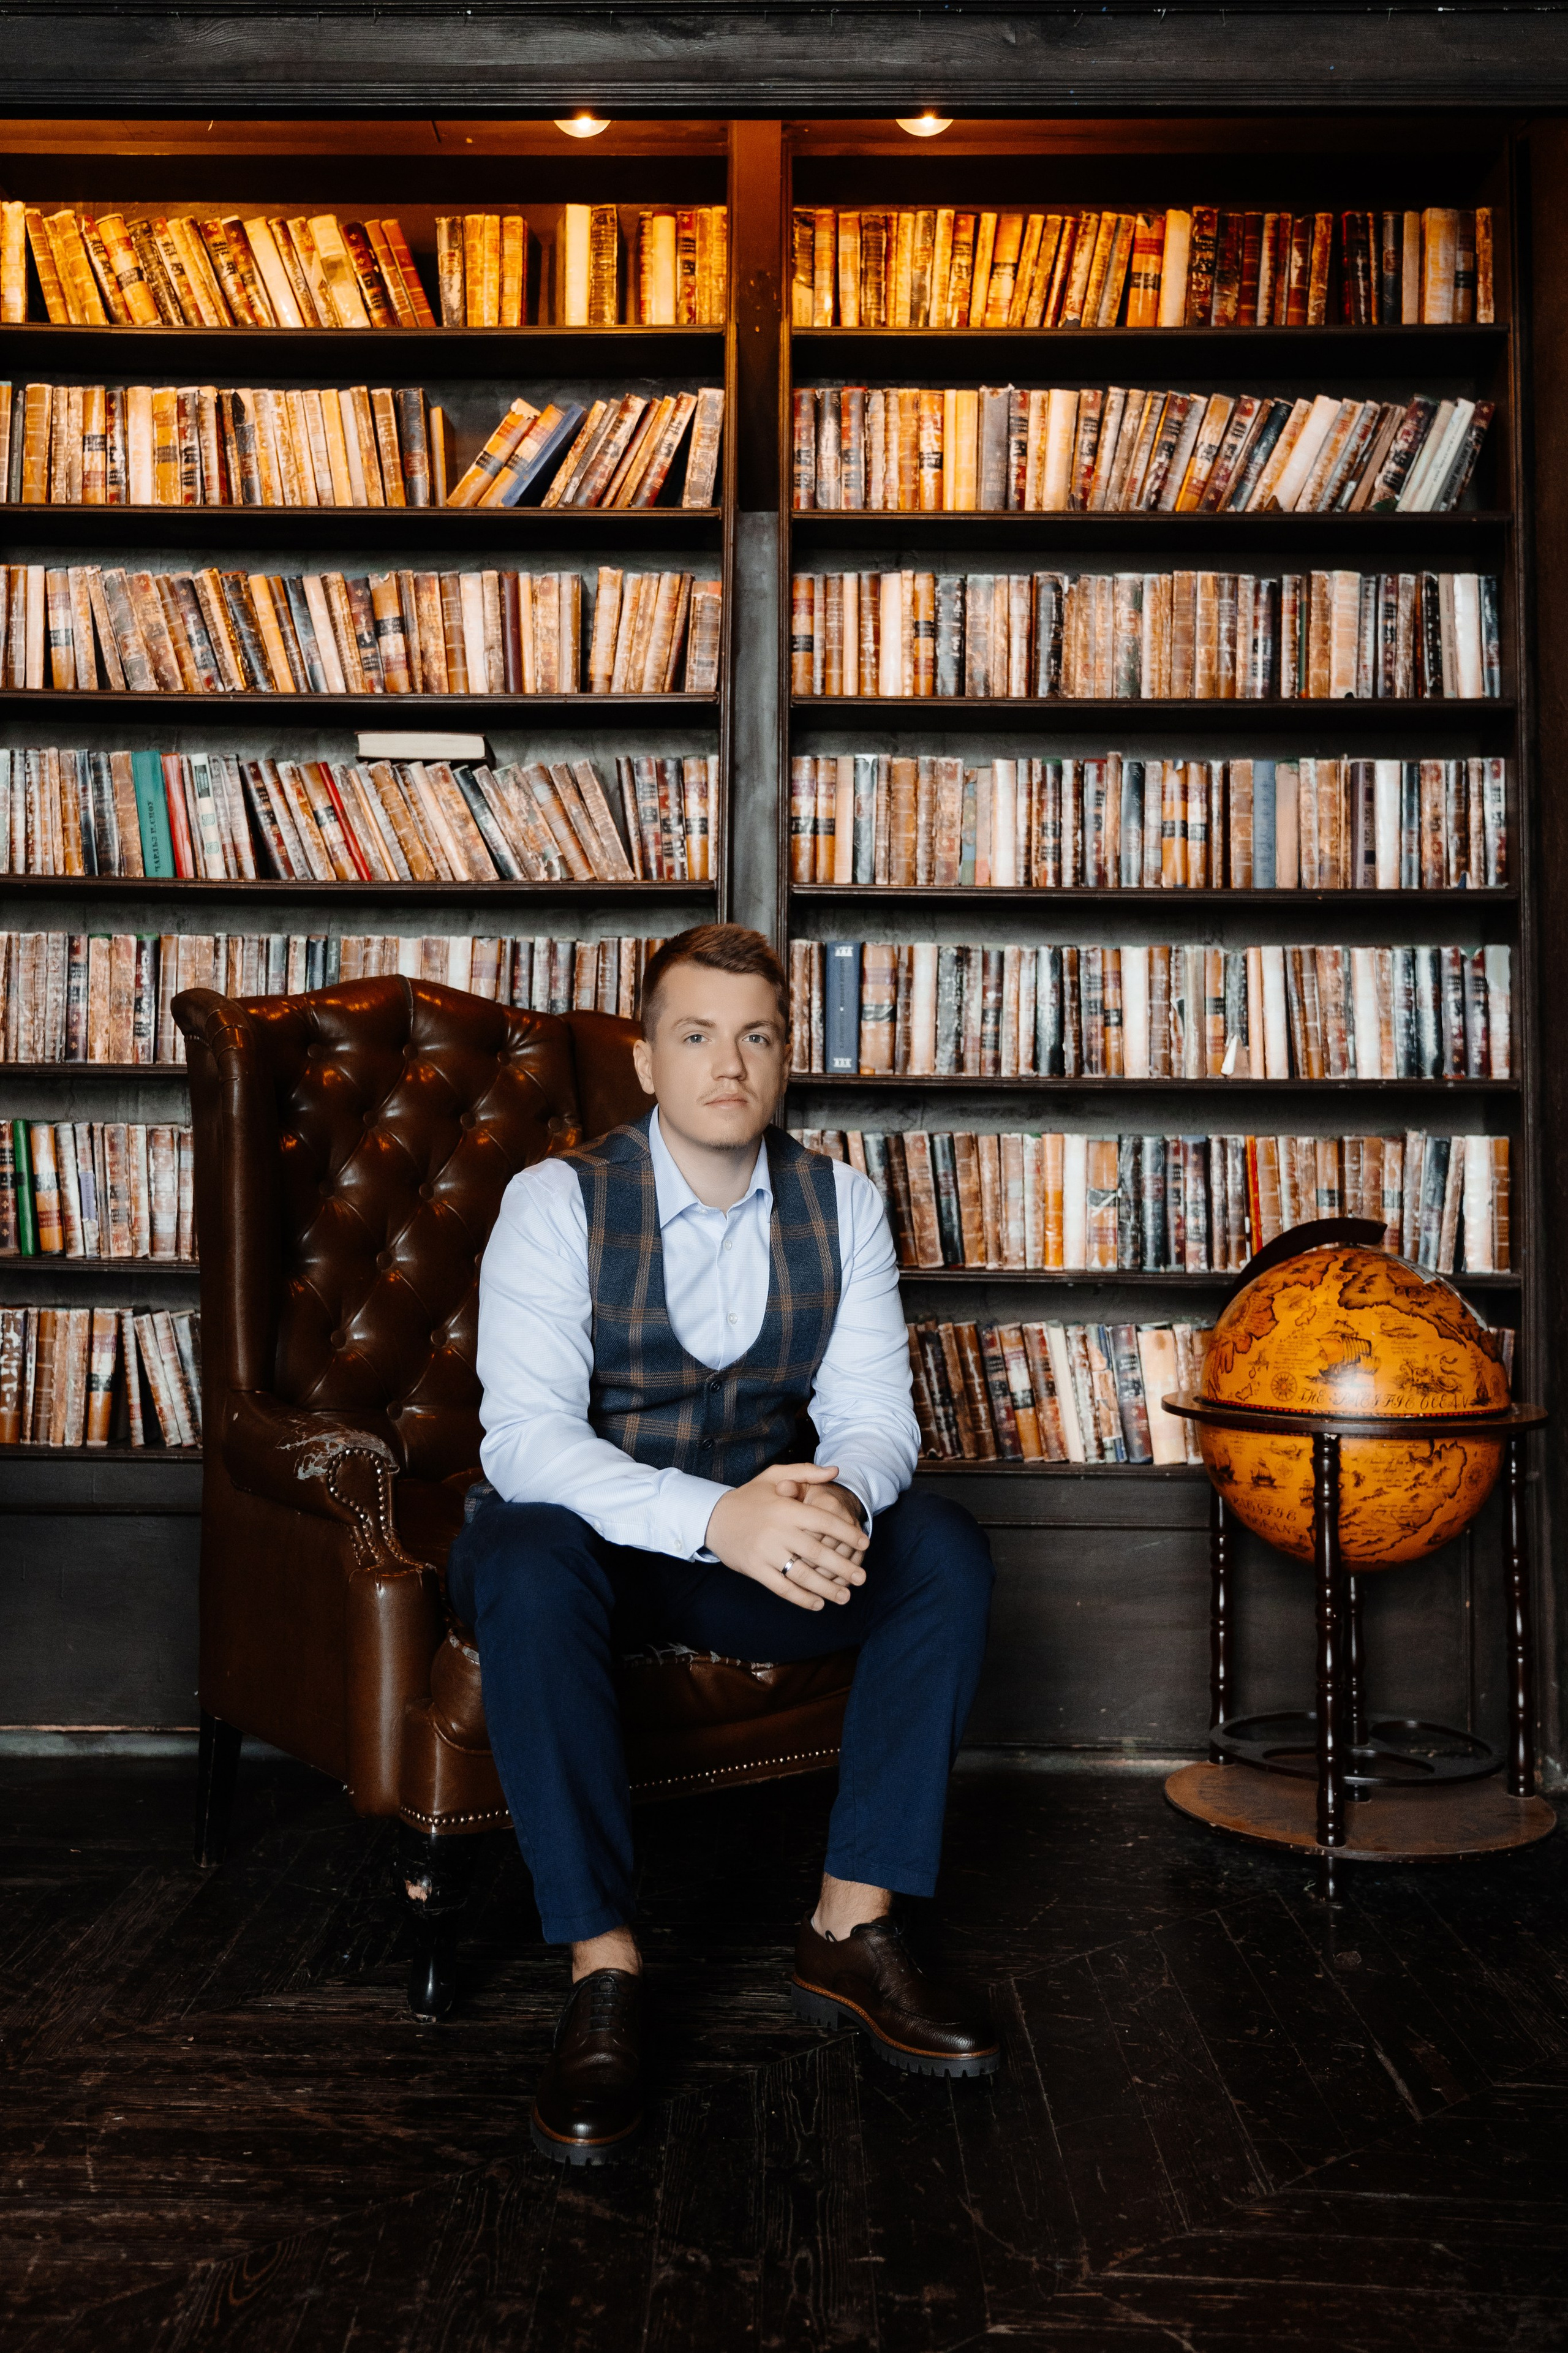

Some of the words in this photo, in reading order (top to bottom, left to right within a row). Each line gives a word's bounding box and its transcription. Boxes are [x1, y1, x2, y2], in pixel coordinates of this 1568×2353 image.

[152, 836, 161, 872] ЧАРЛЬЗ
[1298, 1388, 1326, 1405] THE
[1330, 1391, 1415, 1408] PACIFIC
[1420, 1393, 1469, 1410] OCEAN
